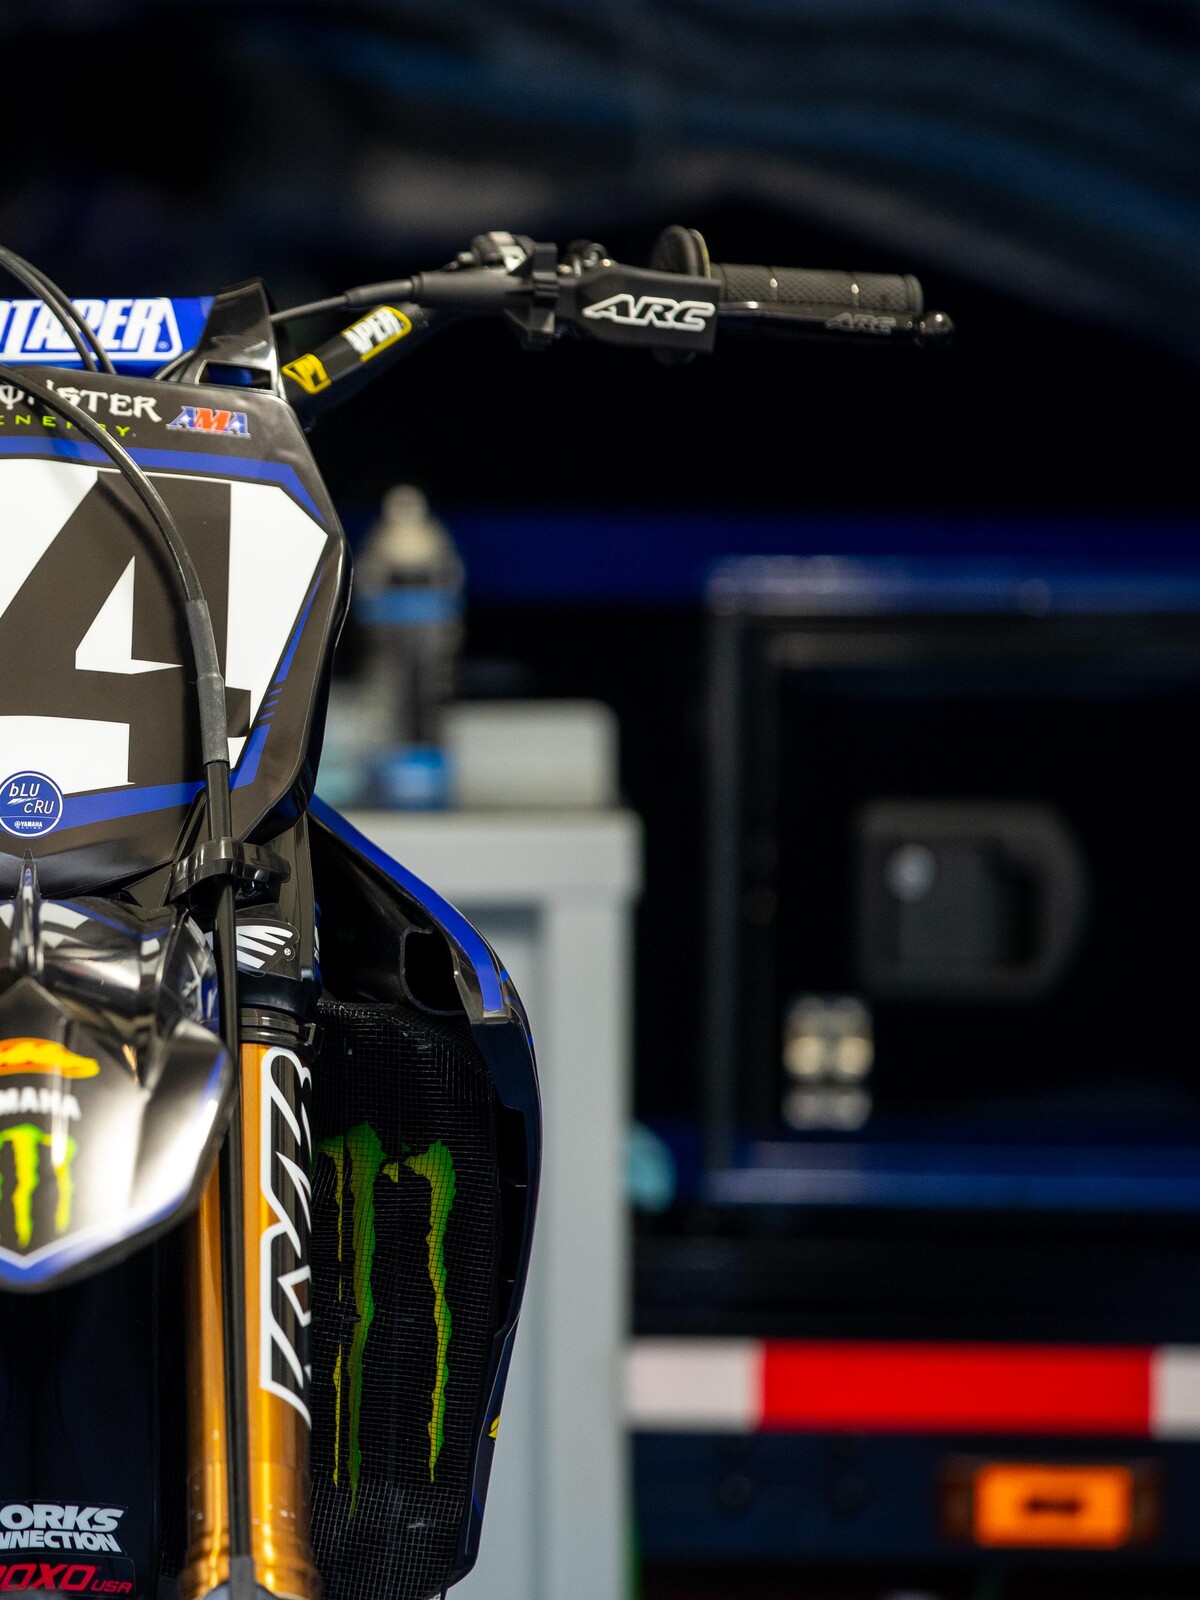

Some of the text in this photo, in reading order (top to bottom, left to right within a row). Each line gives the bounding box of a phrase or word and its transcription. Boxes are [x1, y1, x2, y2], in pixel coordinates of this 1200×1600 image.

[582, 293, 715, 332] ARC
[166, 405, 251, 439] AMA
[90, 1580, 133, 1594] USA
